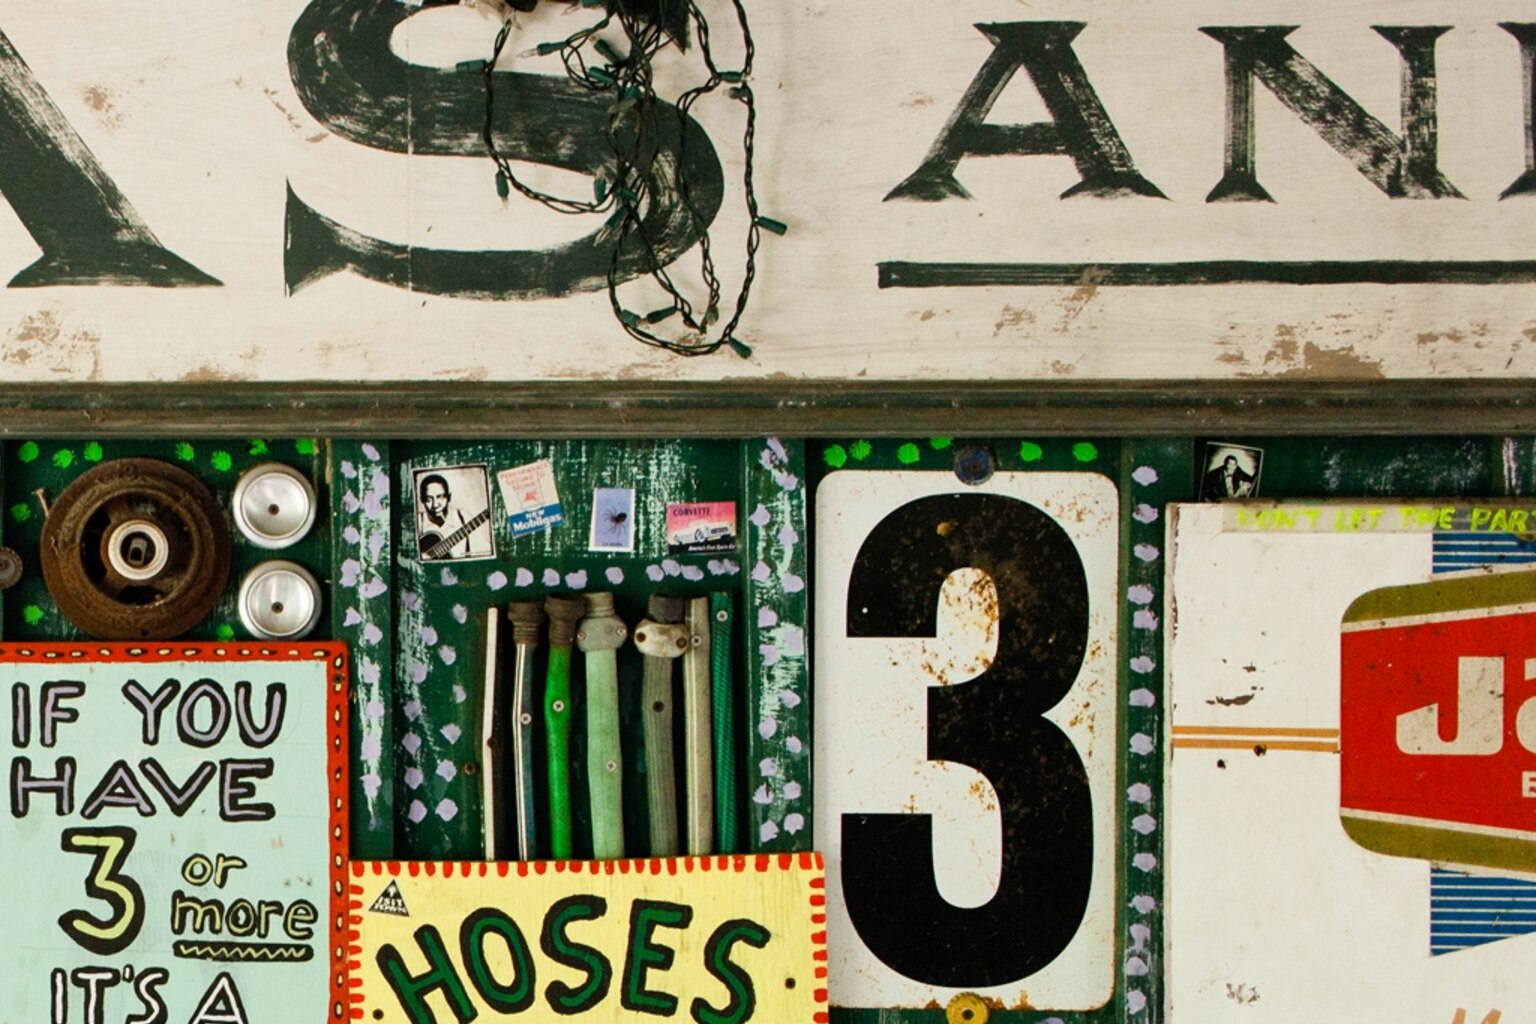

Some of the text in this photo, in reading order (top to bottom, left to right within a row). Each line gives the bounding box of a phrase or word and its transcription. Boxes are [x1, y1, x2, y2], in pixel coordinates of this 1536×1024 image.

[877, 20, 1536, 203] AN
[673, 507, 710, 517] CORVETTE
[1334, 508, 1384, 531] LET
[1397, 505, 1457, 530] THE
[11, 678, 287, 748] IF YOU
[840, 492, 1095, 989] 3
[10, 755, 276, 821] HAVE
[58, 826, 247, 956] 3 or
[170, 889, 318, 940] more
